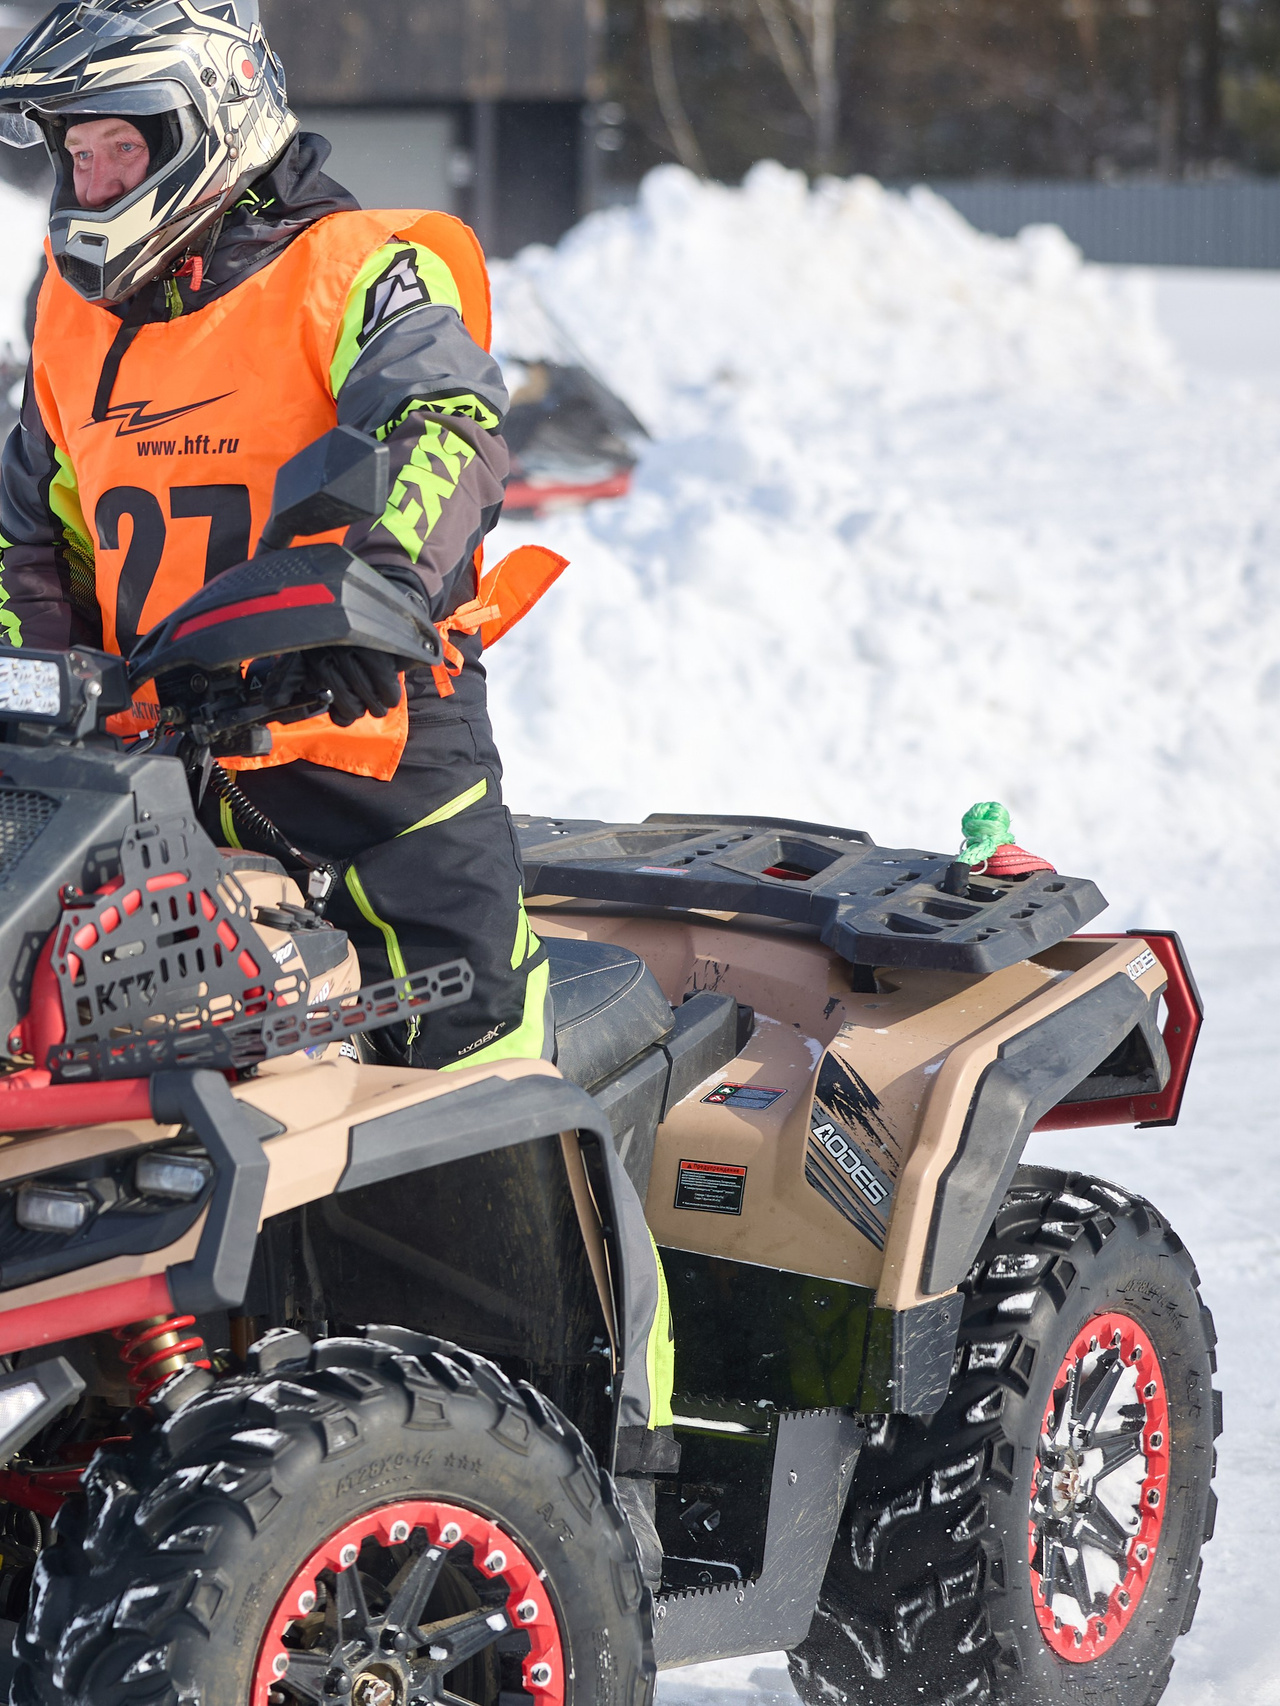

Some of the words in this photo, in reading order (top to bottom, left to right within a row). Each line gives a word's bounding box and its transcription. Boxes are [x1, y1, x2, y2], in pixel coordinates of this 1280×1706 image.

[136, 434, 239, 457] www.hft.ru
[94, 483, 252, 660] 27
[1125, 948, 1157, 981] AODES
[812, 1122, 890, 1206] AODES
